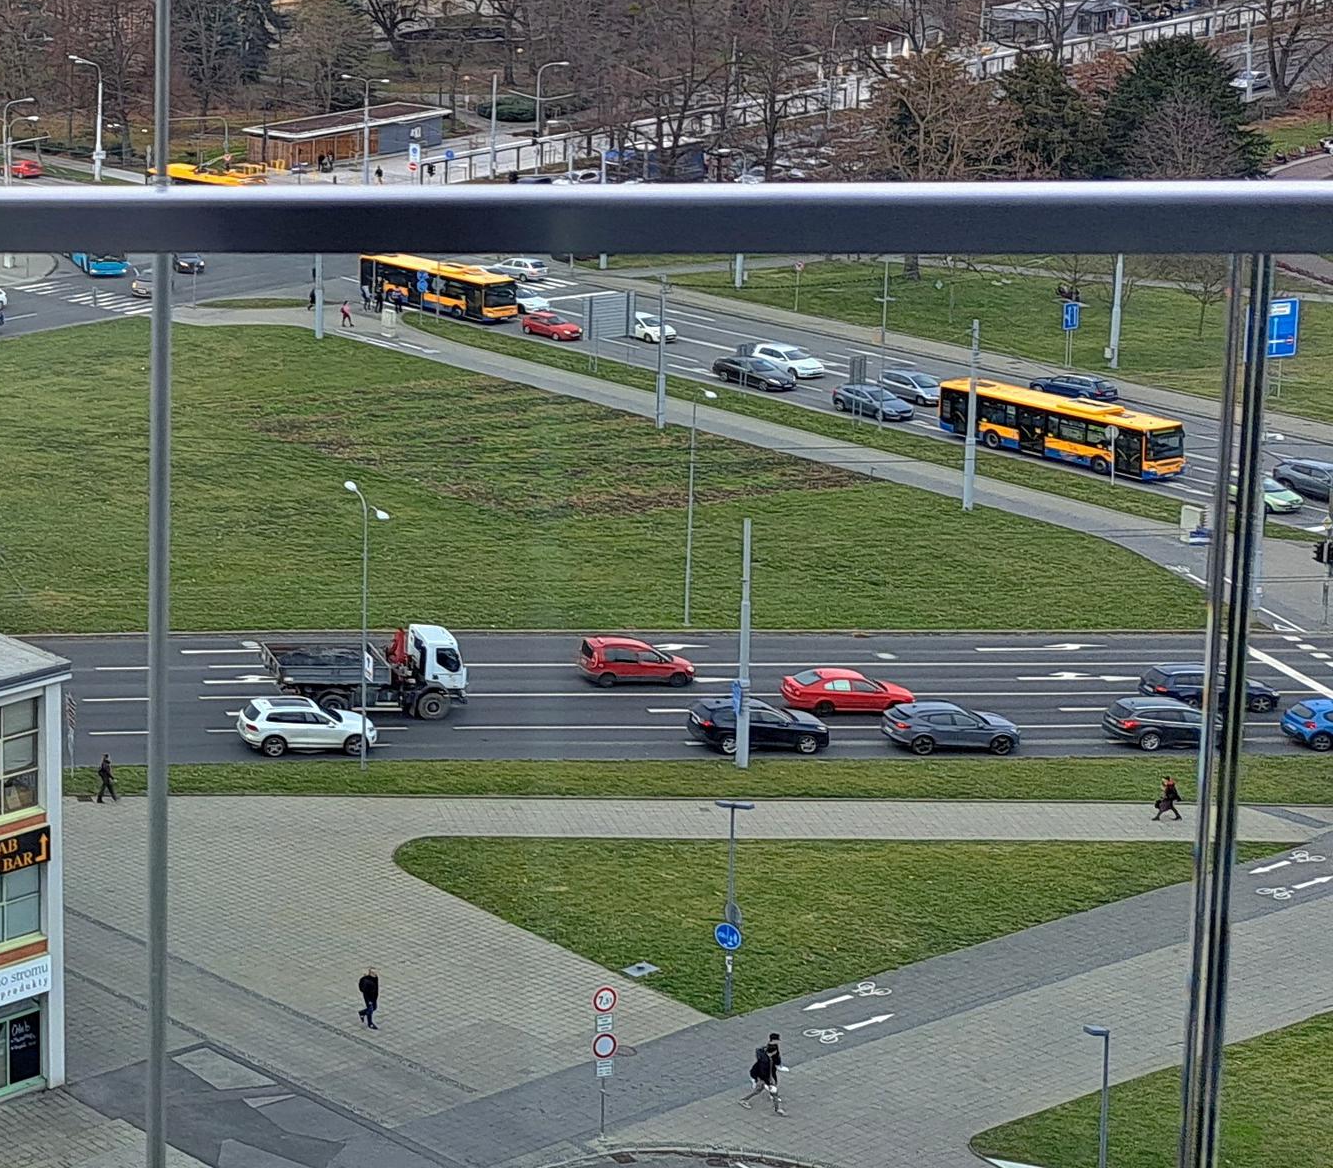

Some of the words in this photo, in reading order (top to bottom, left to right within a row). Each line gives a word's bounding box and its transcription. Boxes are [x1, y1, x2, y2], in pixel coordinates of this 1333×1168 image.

[2, 851, 34, 870] BAR
[11, 963, 49, 983] stromu
[0, 977, 49, 999] produkty
